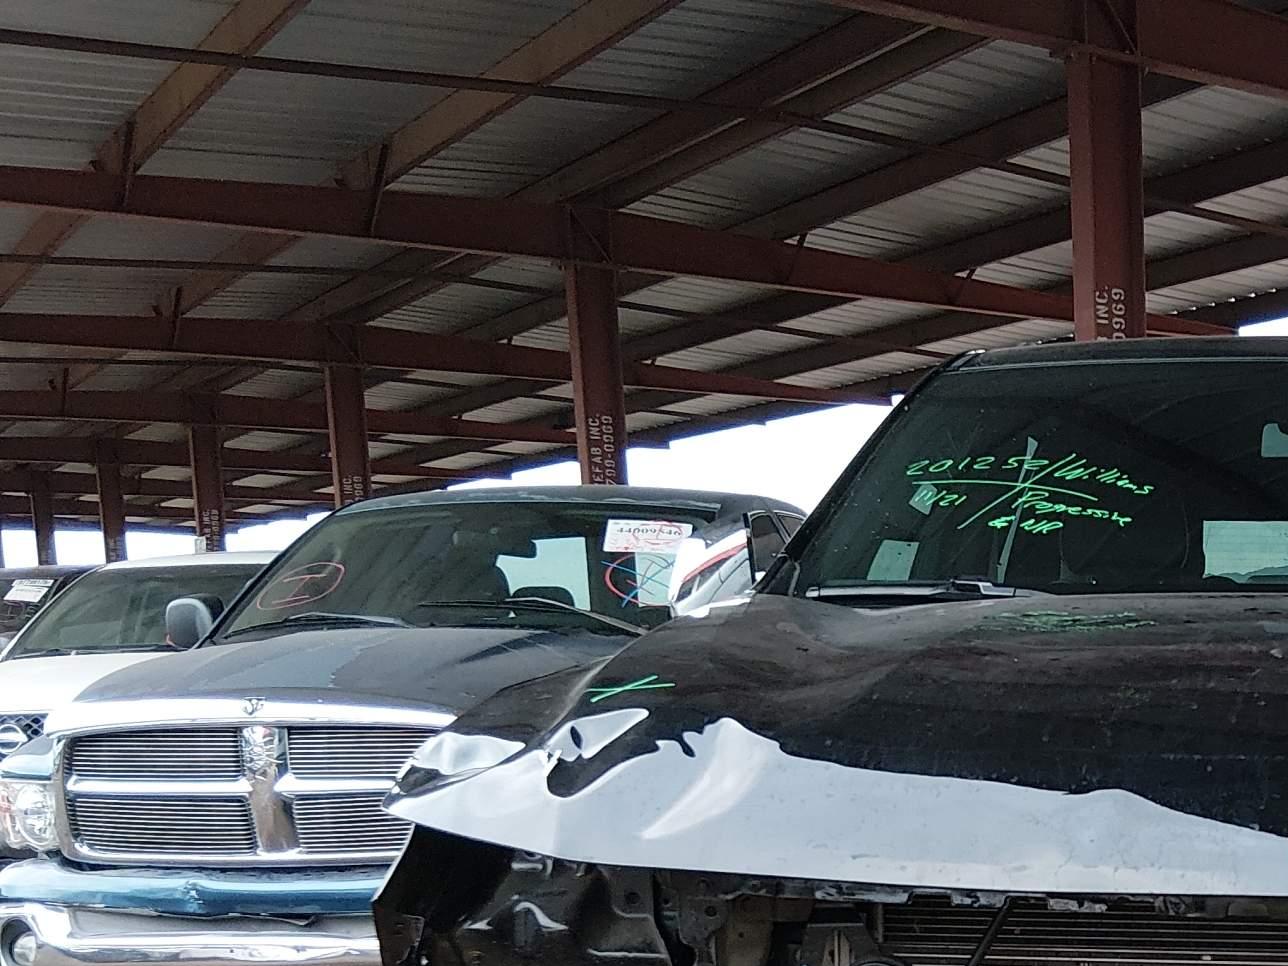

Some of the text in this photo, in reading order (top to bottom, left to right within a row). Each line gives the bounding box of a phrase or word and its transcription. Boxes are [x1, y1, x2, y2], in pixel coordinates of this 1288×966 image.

[1095, 285, 1110, 325] INC.
[588, 413, 605, 486] EFAB INC.
[906, 456, 996, 475] 2012
